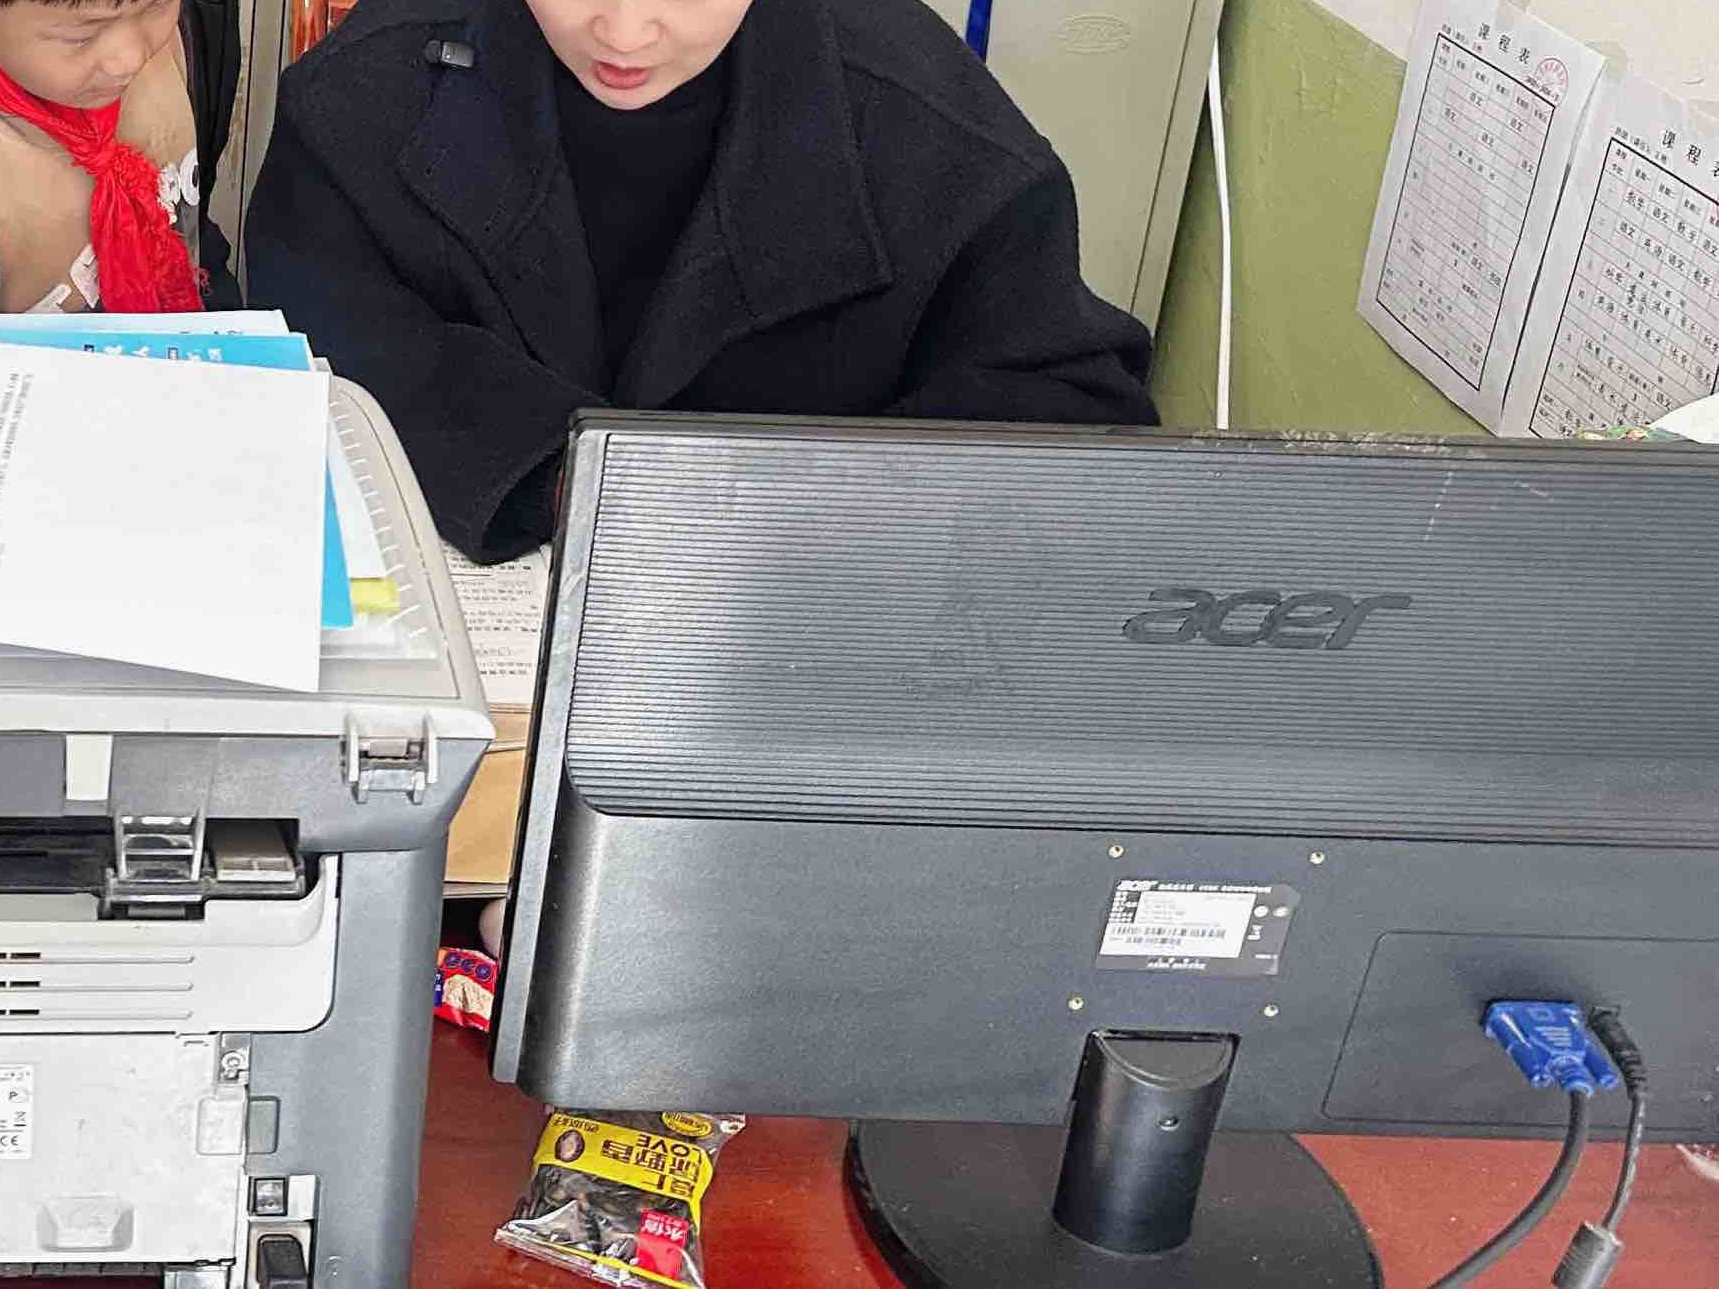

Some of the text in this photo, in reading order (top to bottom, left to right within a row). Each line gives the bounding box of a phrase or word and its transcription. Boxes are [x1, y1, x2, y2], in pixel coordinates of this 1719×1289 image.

[1477, 22, 1531, 65] 课程表
[1121, 587, 1412, 650] acer
[637, 1132, 705, 1160] LOVE
